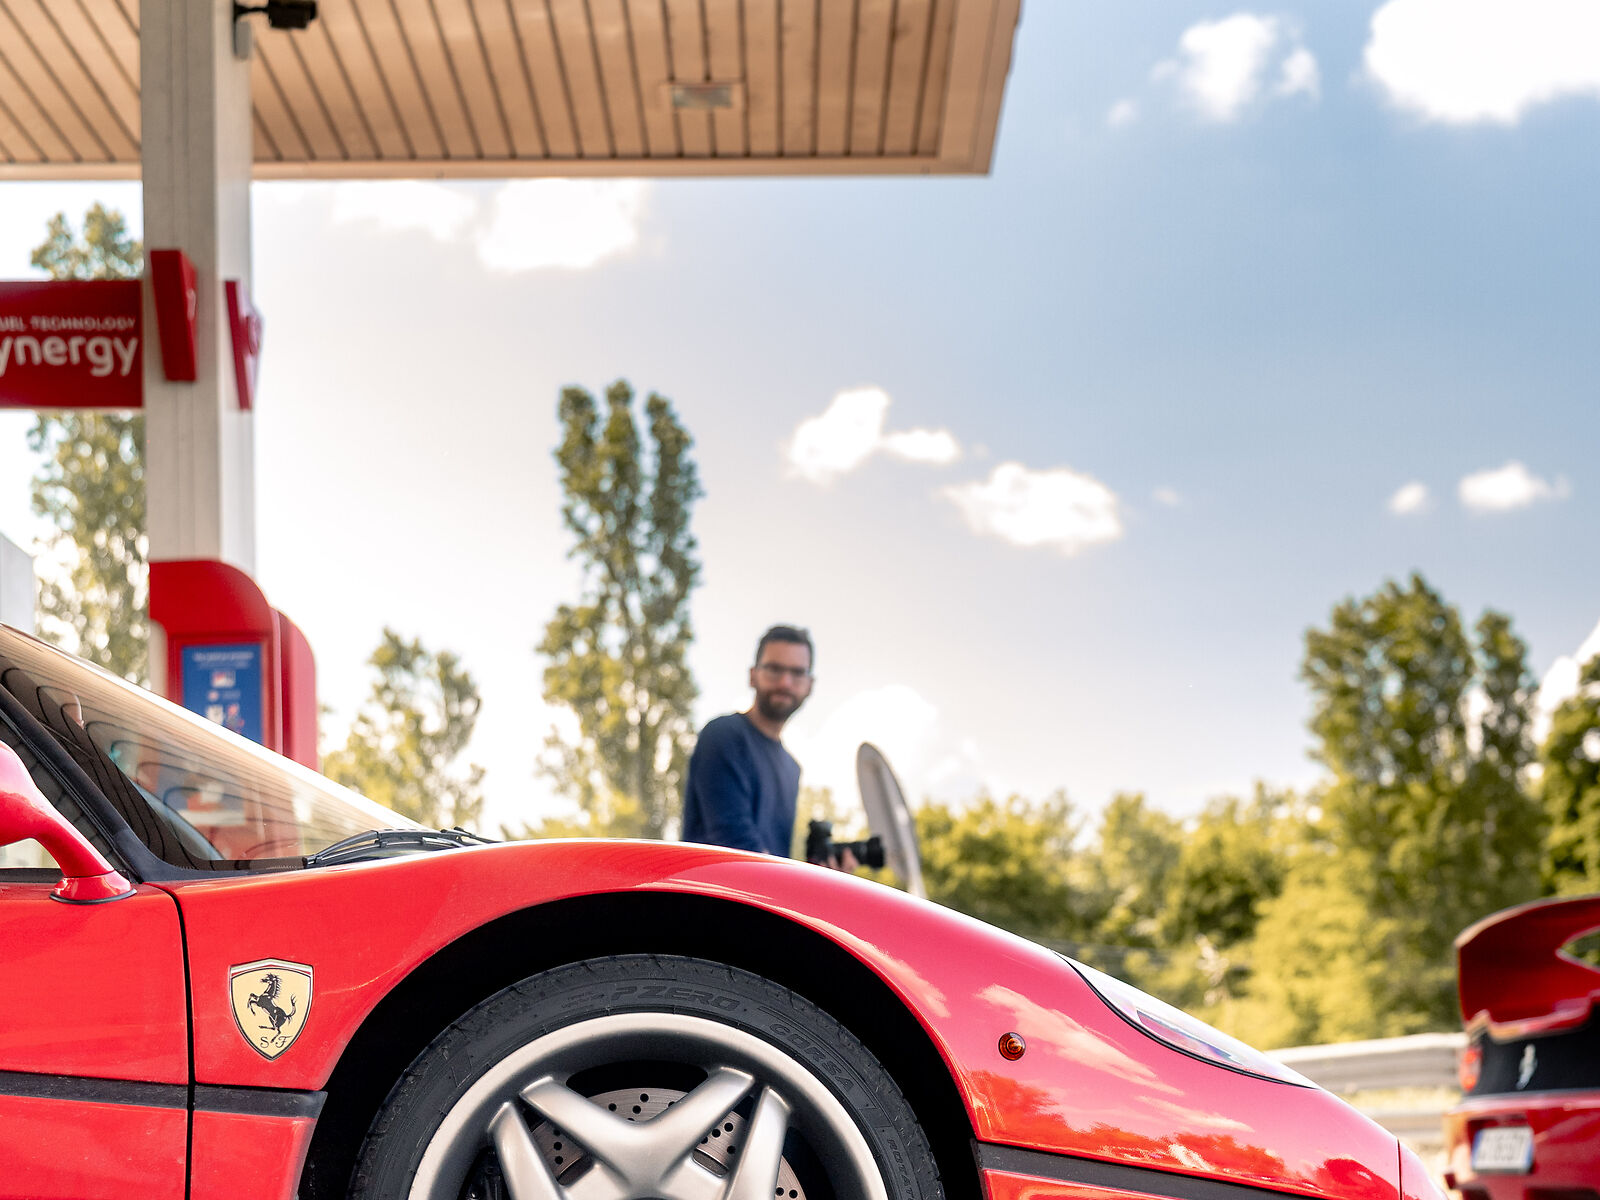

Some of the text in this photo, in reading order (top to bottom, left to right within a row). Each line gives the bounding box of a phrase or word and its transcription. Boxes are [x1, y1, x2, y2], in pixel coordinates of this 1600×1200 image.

[0, 316, 136, 331] UEL TECHNOLOGY
[0, 335, 138, 377] ynergy
[768, 1019, 854, 1091] CORSA
